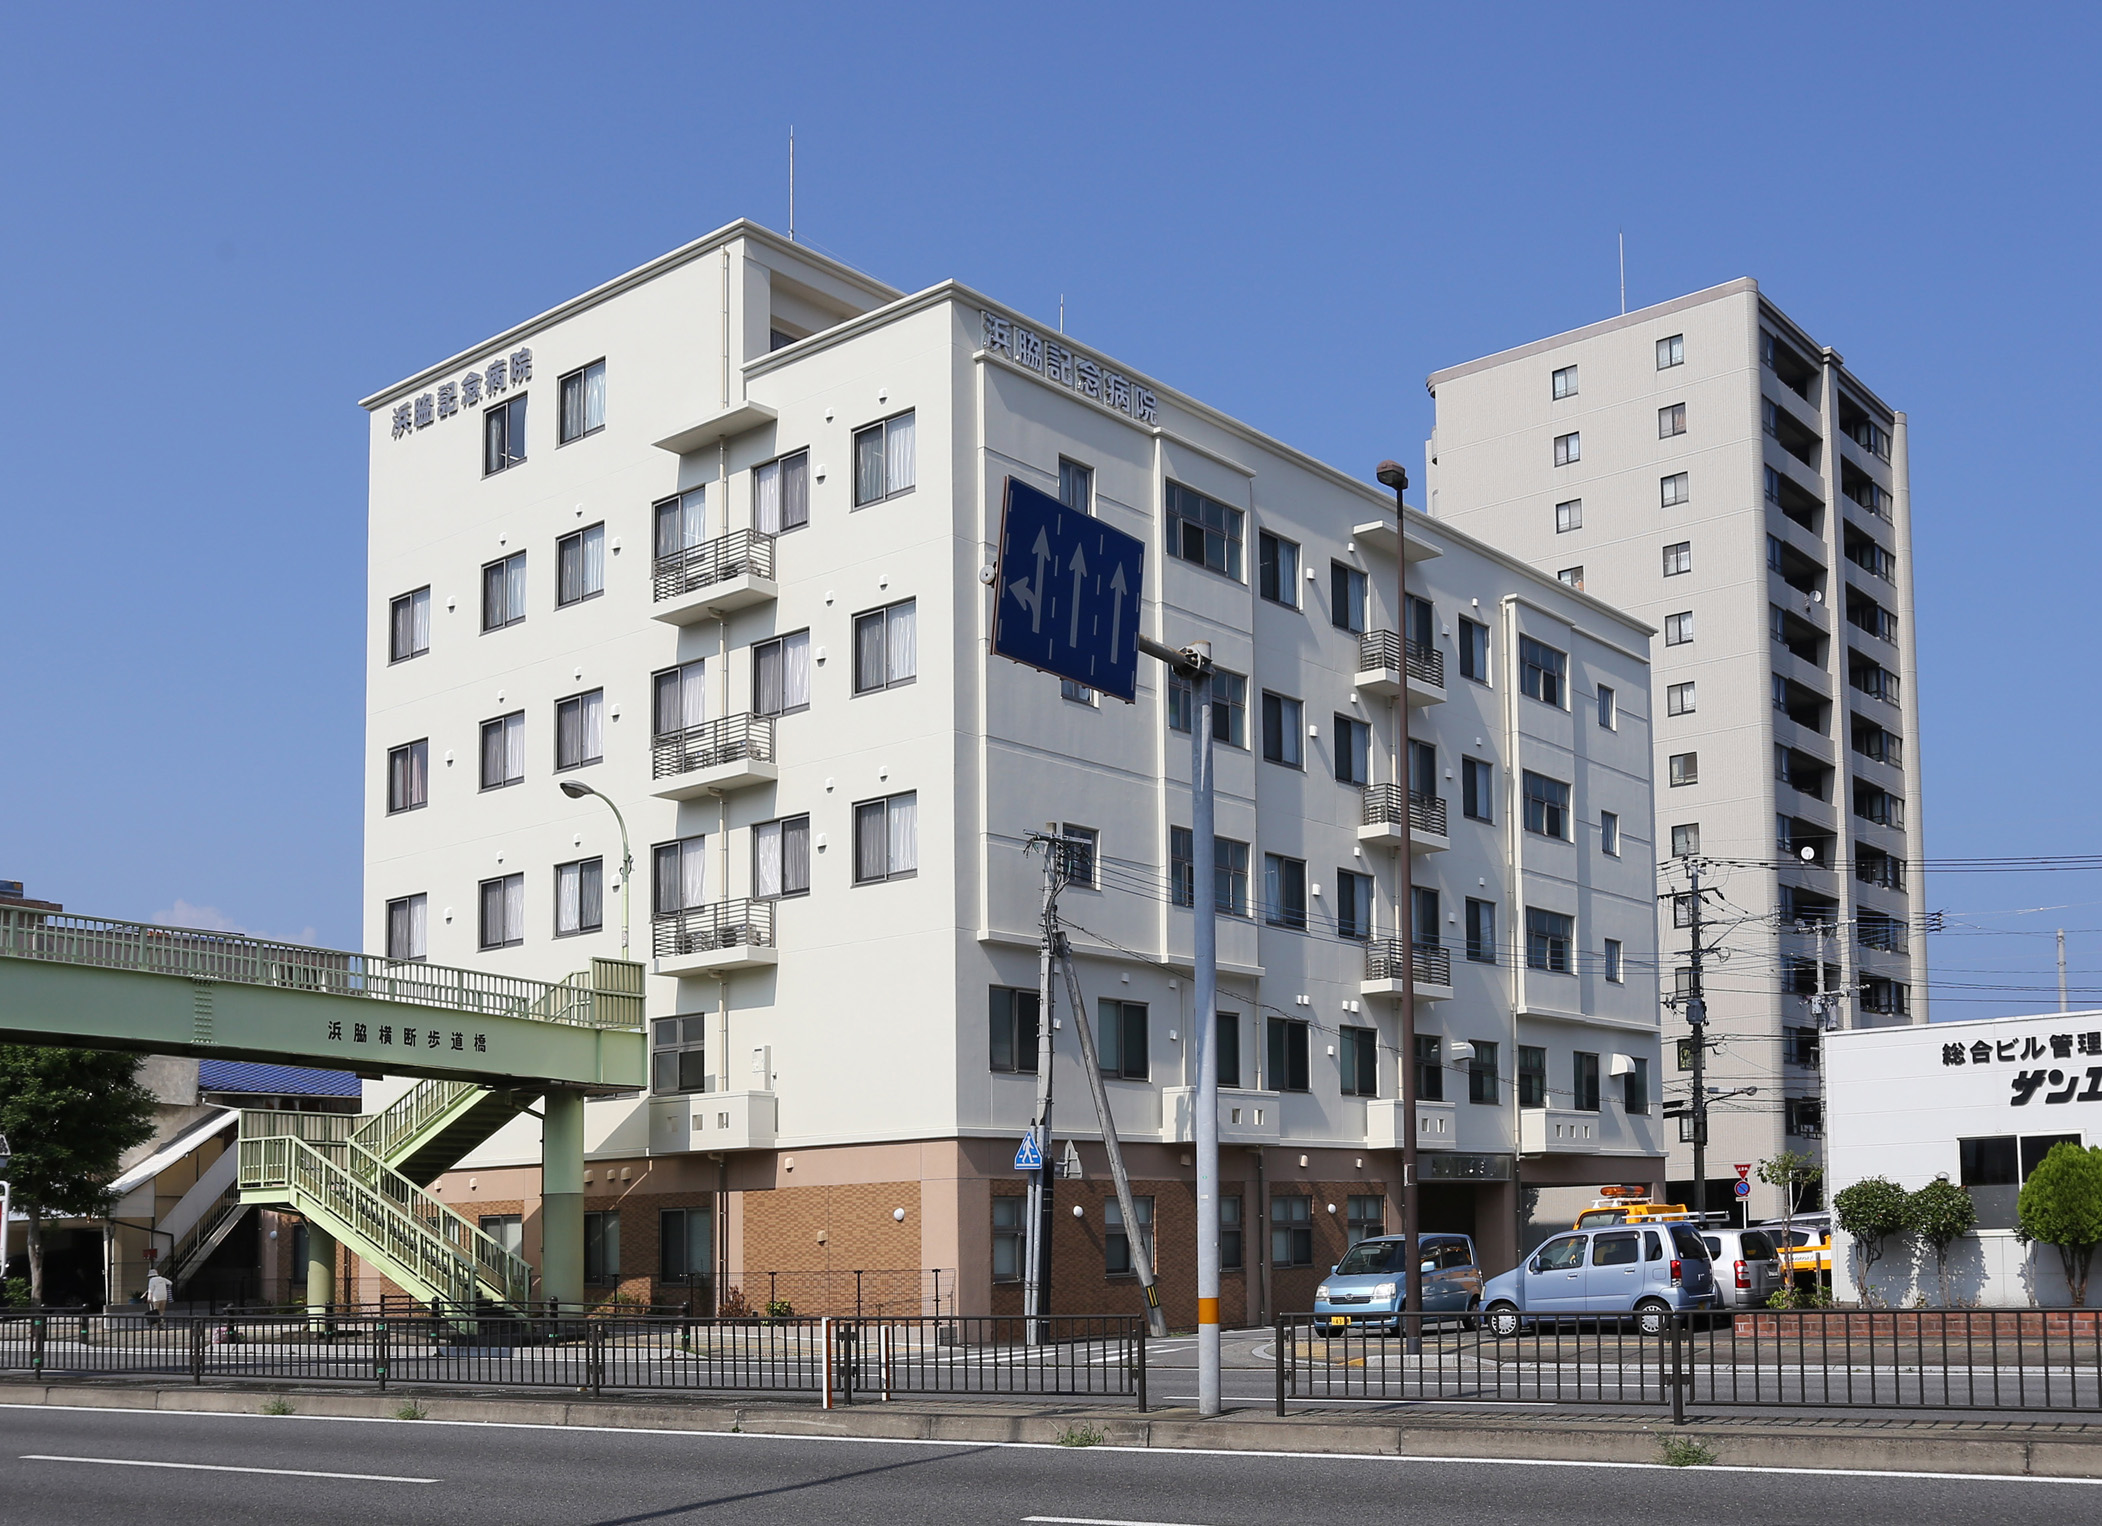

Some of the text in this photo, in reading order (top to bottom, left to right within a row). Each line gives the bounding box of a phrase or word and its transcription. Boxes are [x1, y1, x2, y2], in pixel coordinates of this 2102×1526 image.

[391, 347, 532, 441] 浜脇記念病院
[983, 312, 1158, 426] 浜脇記念病院
[327, 1020, 487, 1053] 浜脇横断歩道橋
[1942, 1031, 2102, 1066] 総合ビル管理
